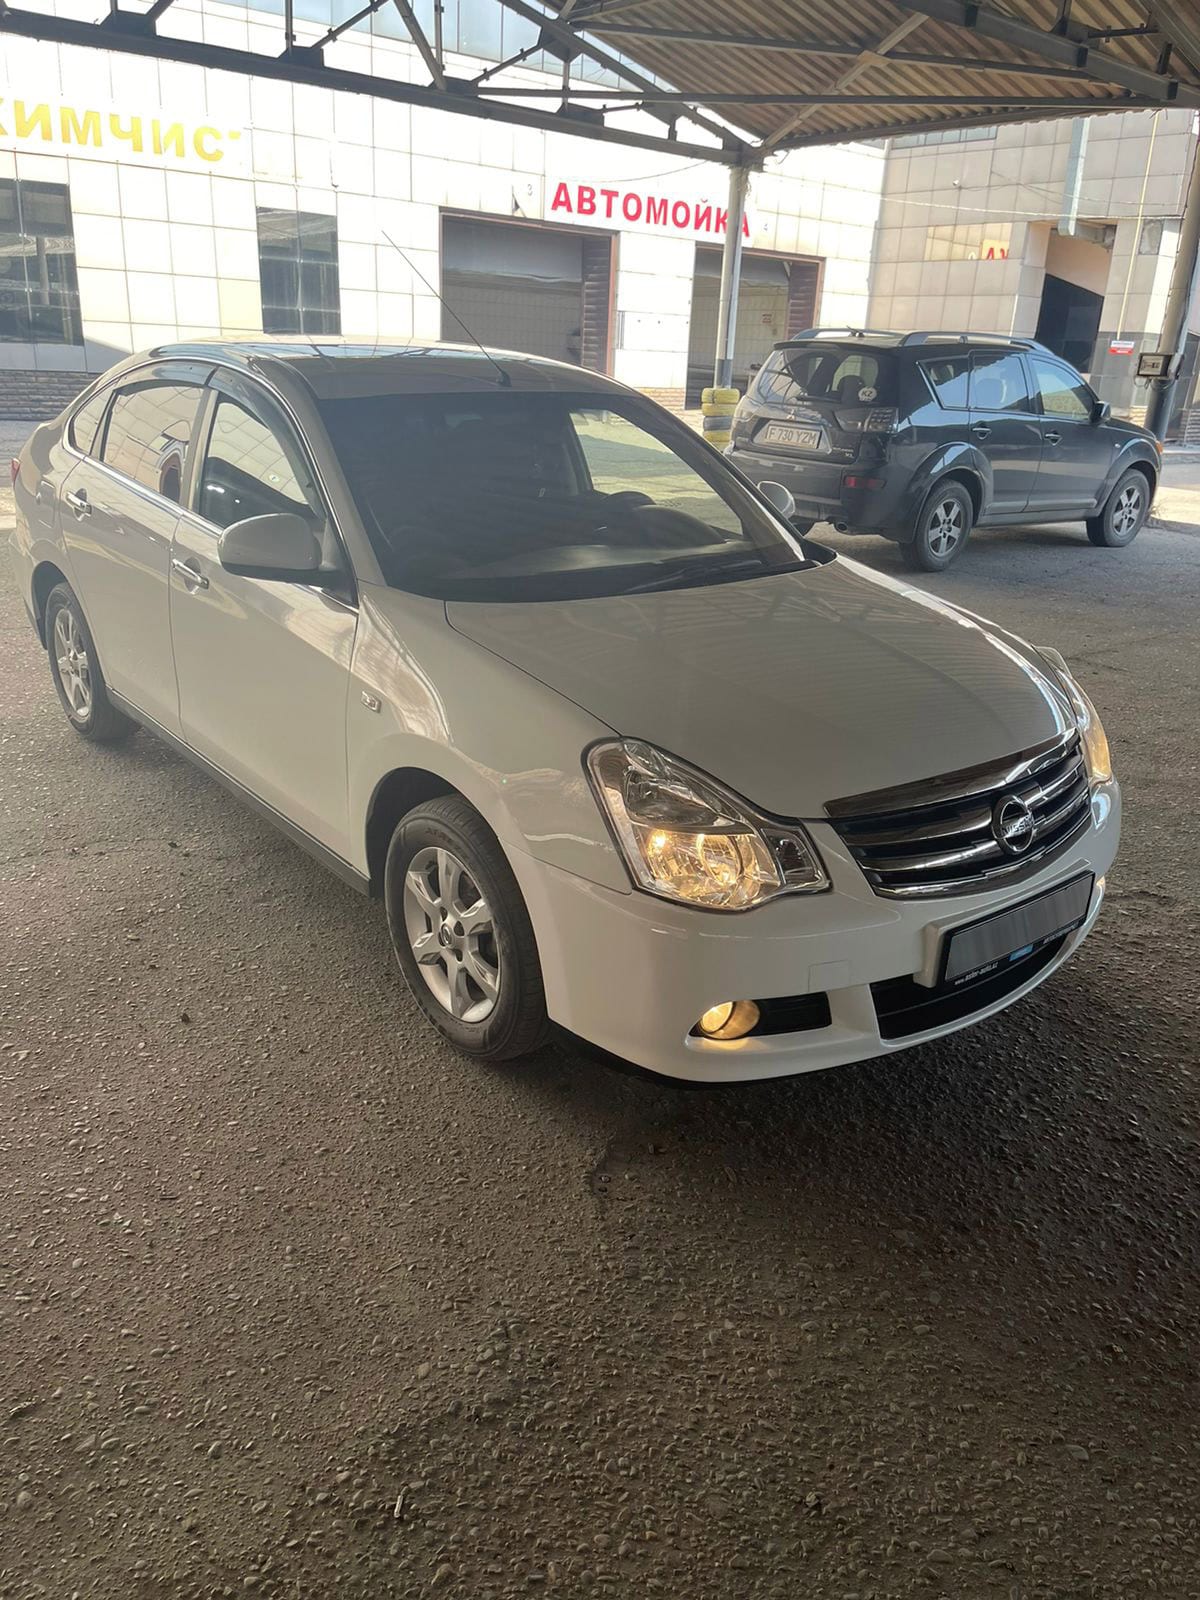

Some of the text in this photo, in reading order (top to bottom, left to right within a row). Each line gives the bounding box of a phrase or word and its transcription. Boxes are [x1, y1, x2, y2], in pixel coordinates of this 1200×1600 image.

[0, 97, 241, 162] ИМЧИС
[769, 427, 817, 445] F 730 YZM
